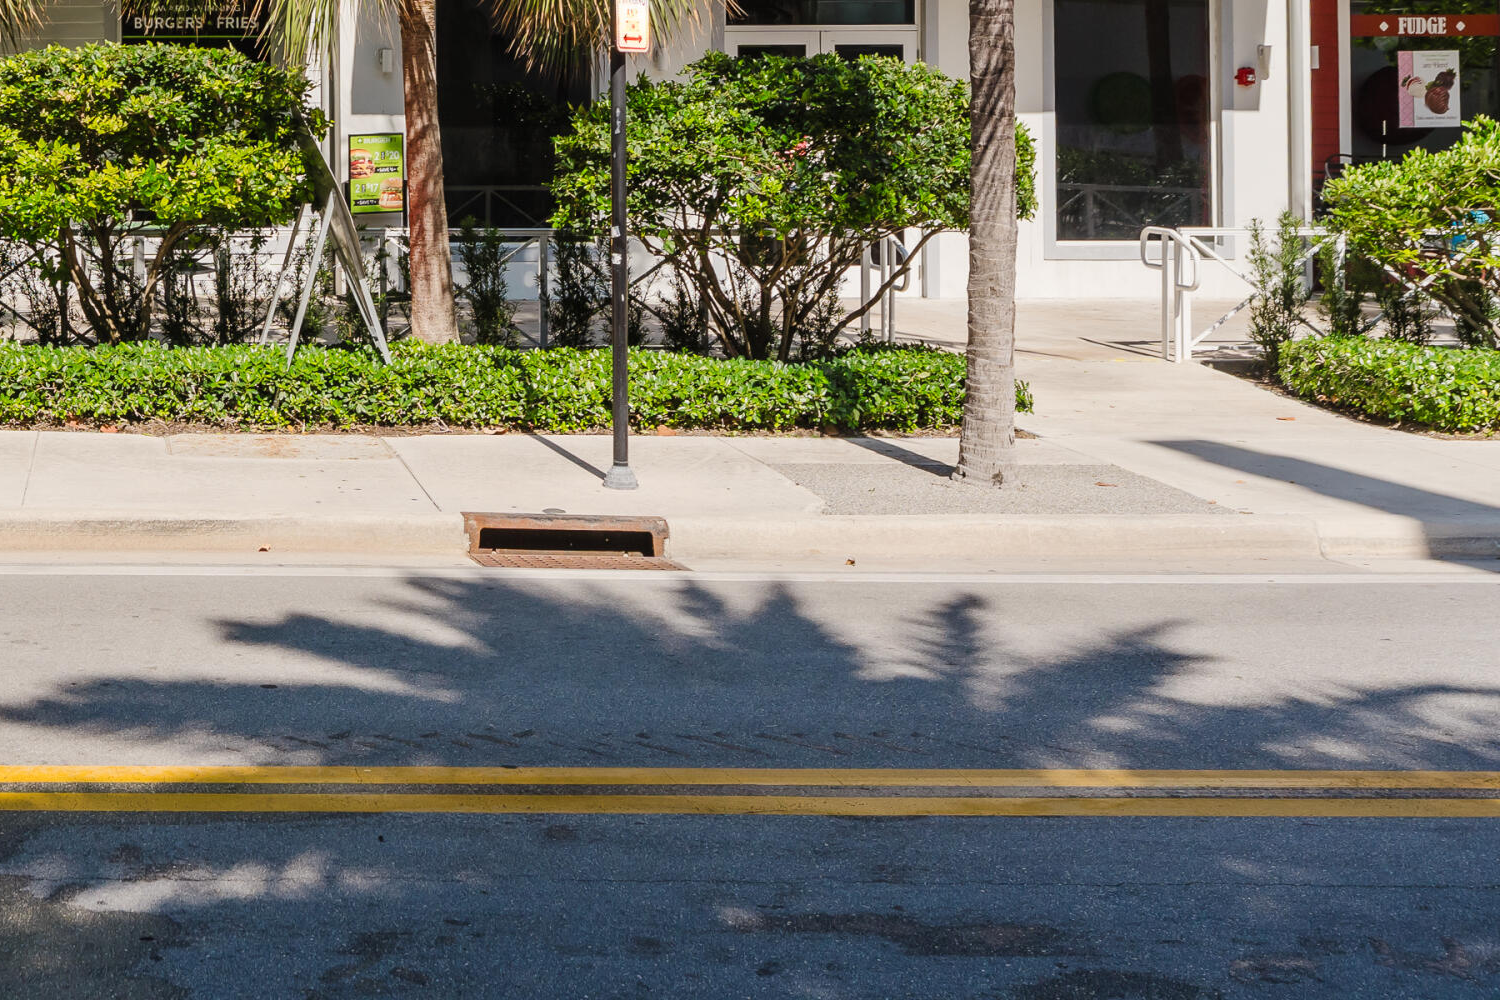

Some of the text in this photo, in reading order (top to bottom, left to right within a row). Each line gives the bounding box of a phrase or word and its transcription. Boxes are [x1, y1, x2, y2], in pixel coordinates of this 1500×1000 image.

[134, 16, 259, 30] BURGERS FRIES
[1397, 16, 1447, 35] FUDGE
